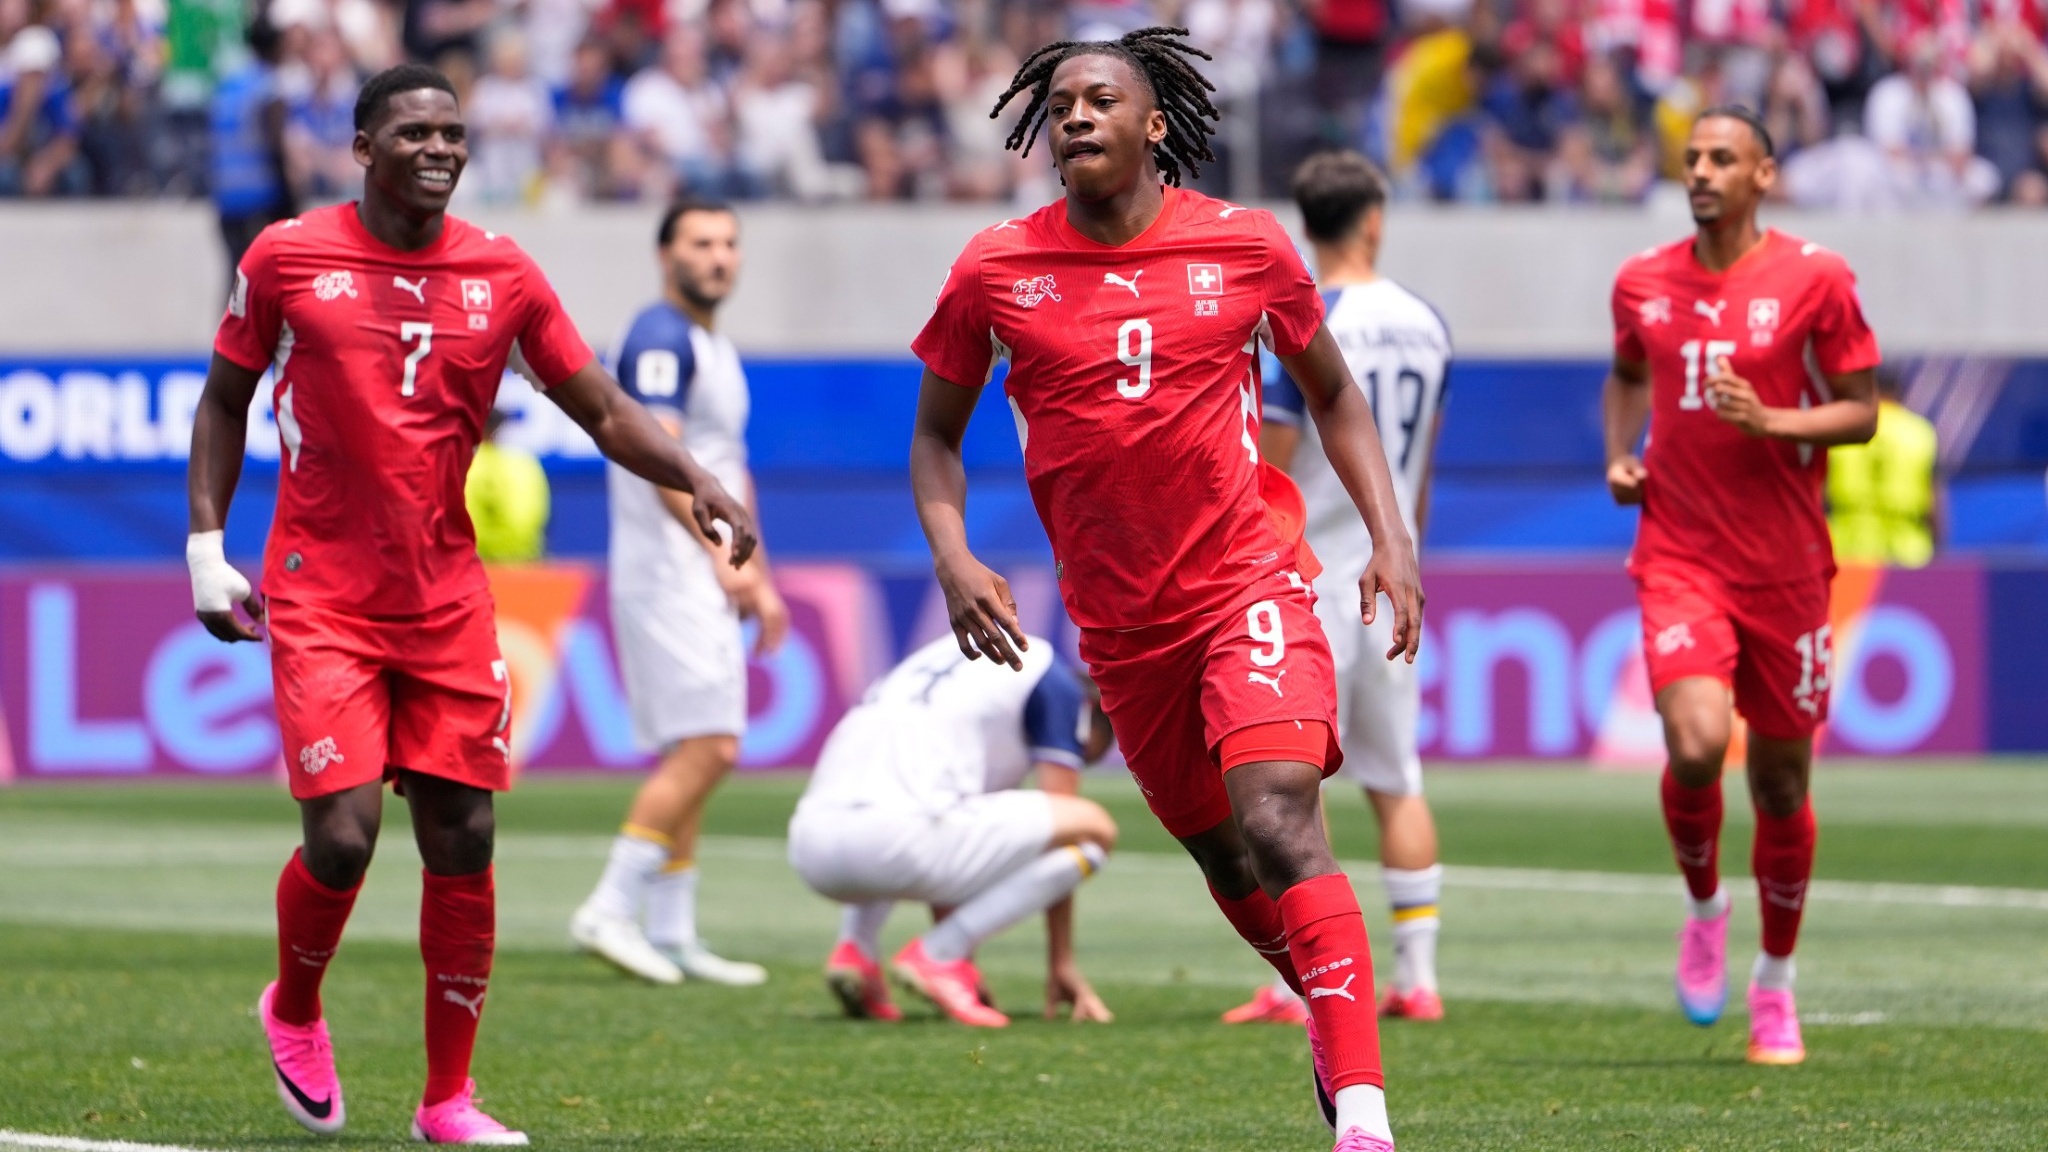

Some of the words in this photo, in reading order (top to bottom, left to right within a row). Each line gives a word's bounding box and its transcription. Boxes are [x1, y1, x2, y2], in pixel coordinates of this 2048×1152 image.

[401, 321, 433, 397] 7
[1116, 318, 1153, 398] 9
[1246, 600, 1285, 667] 9
[1793, 623, 1832, 698] 15
[1301, 957, 1353, 982] suisse
